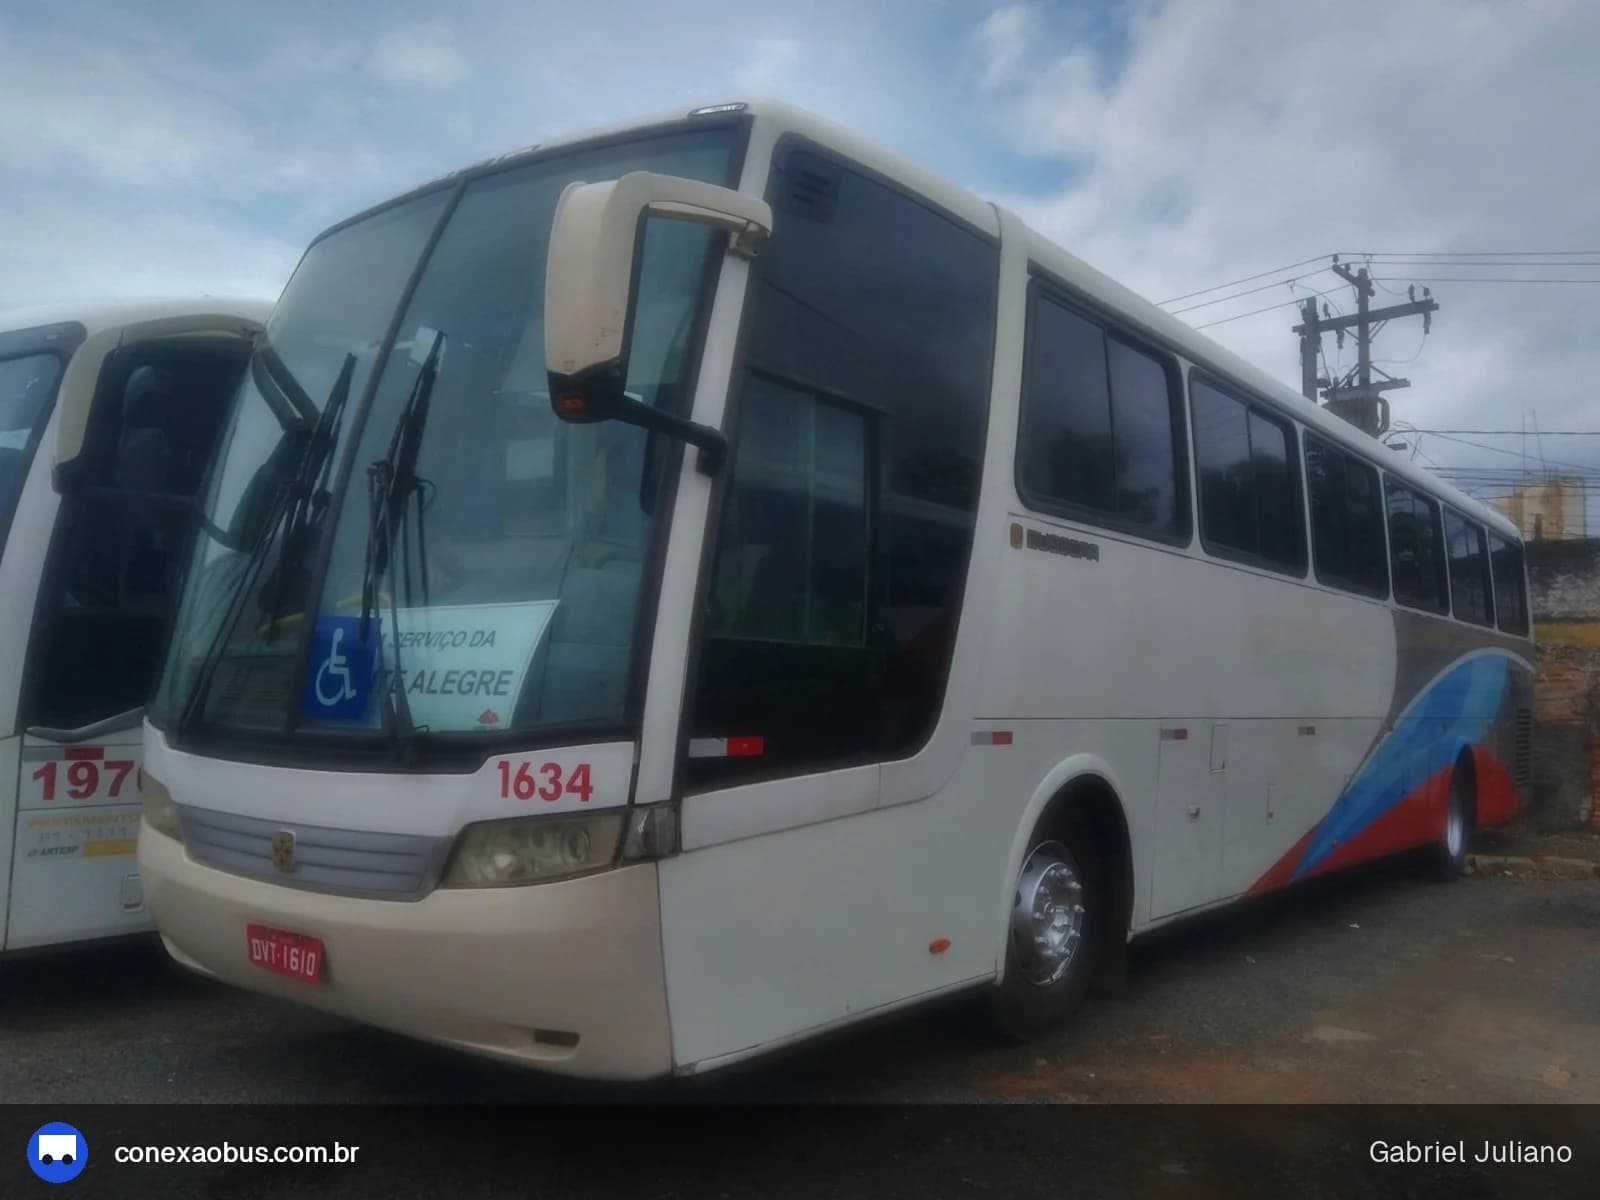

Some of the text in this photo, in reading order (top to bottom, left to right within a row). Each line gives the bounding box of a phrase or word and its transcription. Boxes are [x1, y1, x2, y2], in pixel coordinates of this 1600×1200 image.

[469, 630, 496, 648] DA
[408, 669, 514, 696] ALEGRE
[32, 760, 143, 800] 197
[498, 760, 593, 803] 1634
